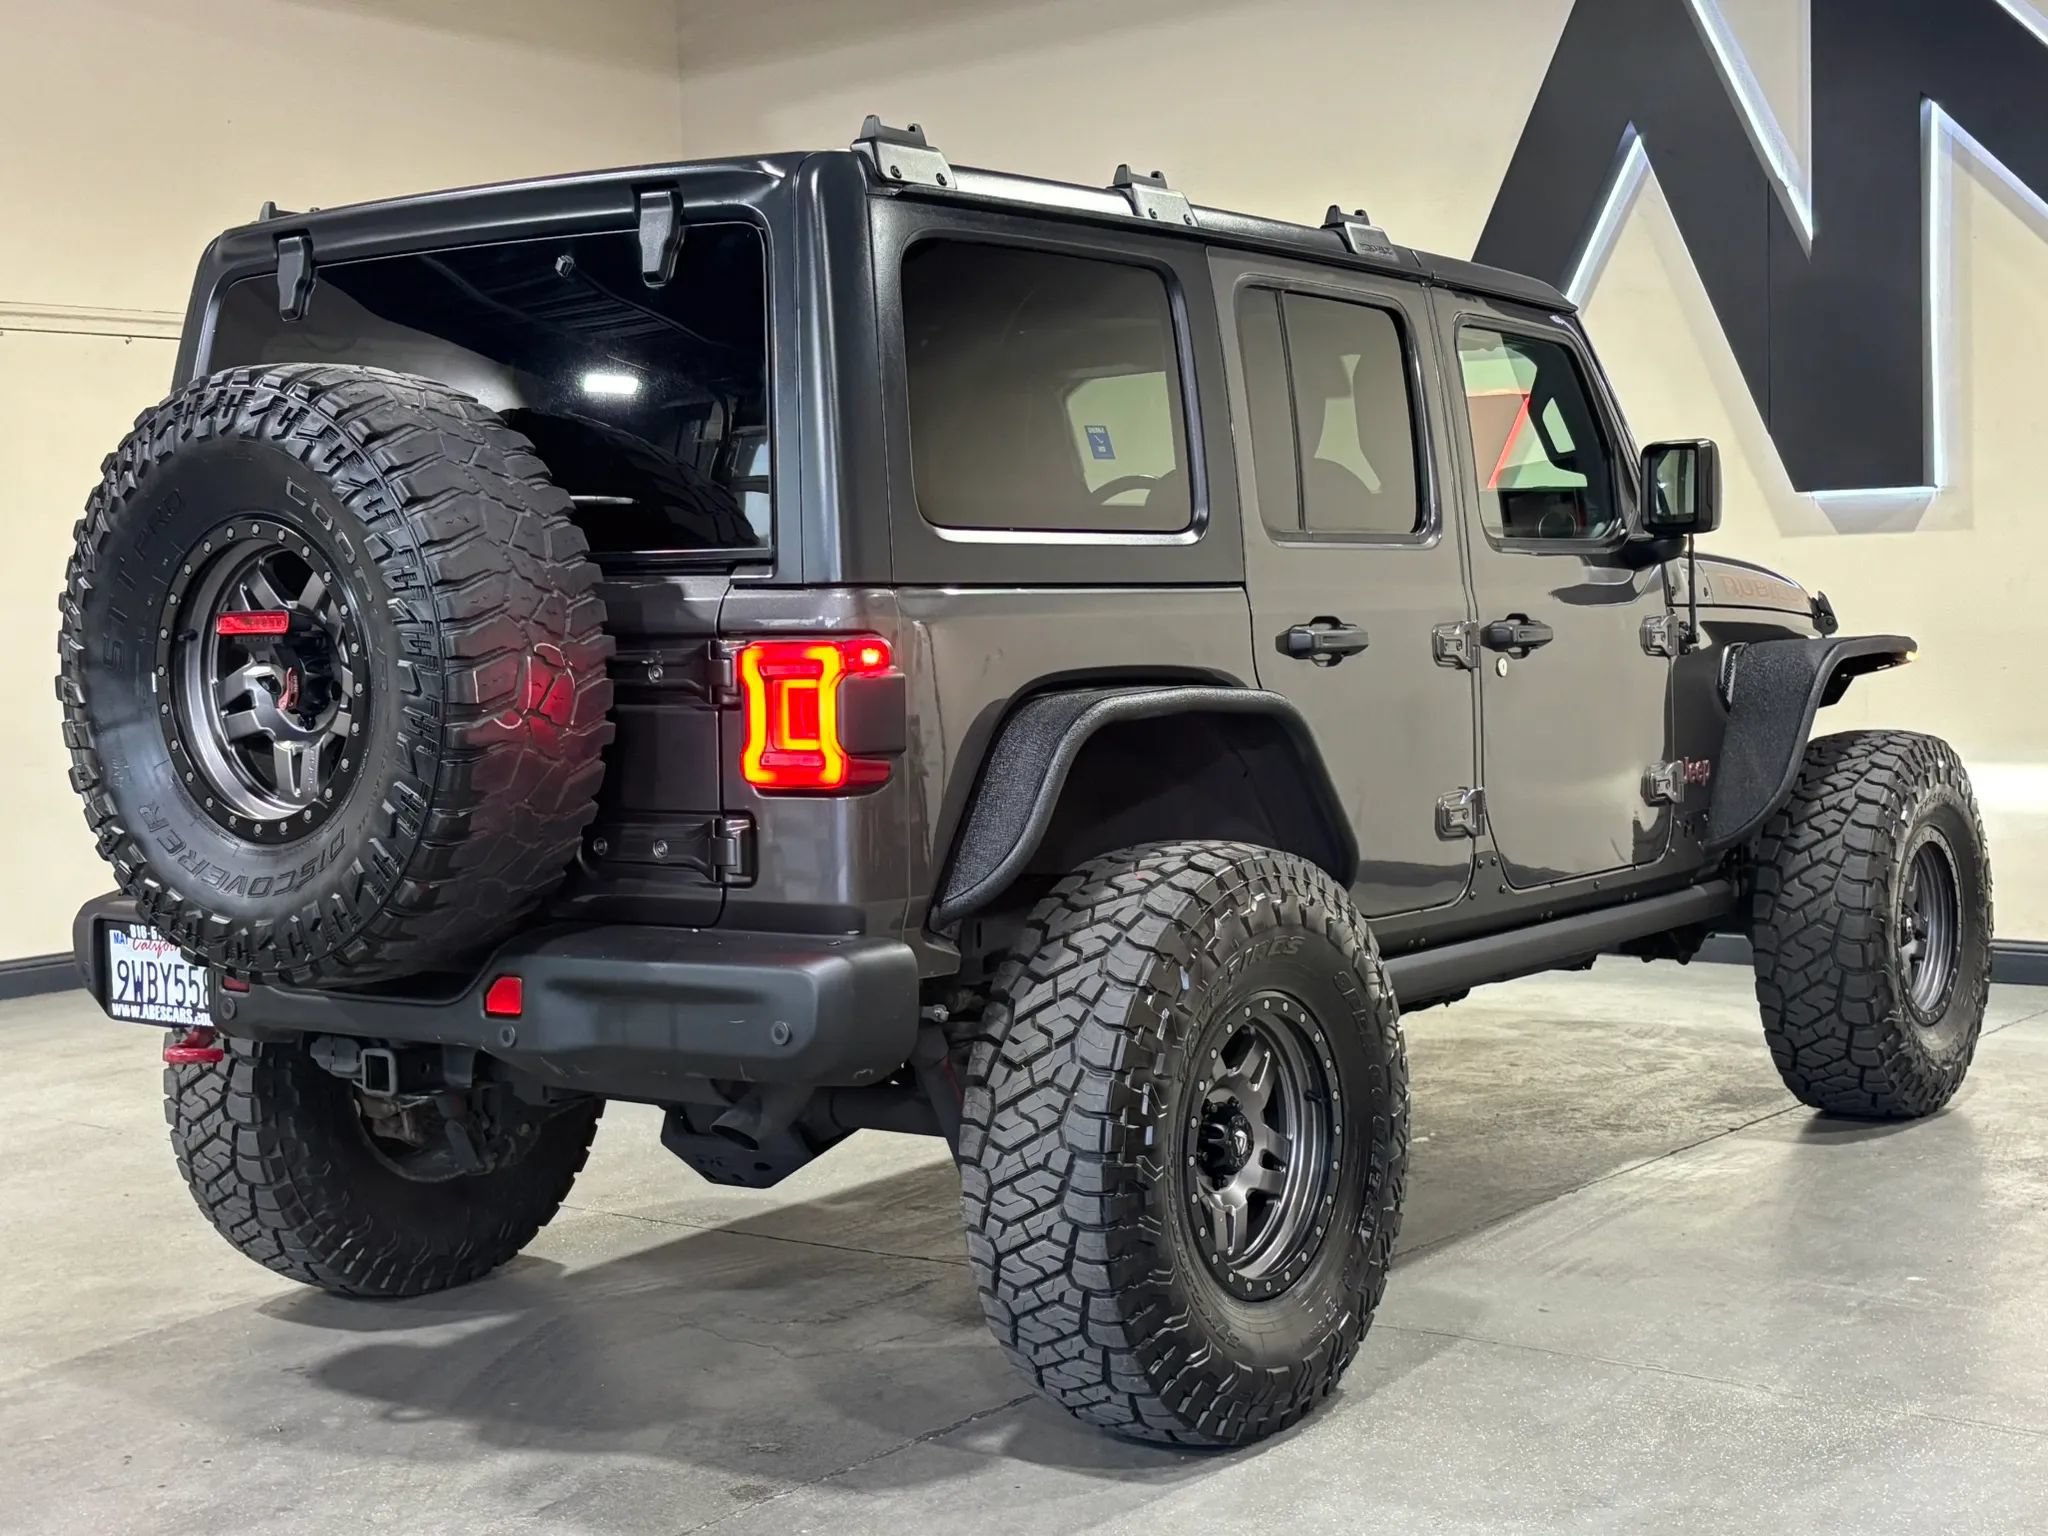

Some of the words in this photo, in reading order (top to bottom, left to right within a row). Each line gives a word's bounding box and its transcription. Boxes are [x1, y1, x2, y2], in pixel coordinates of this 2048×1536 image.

[285, 475, 389, 692] COOPR
[1682, 756, 1711, 787] Jeep
[137, 800, 347, 900] DISCOVERER
